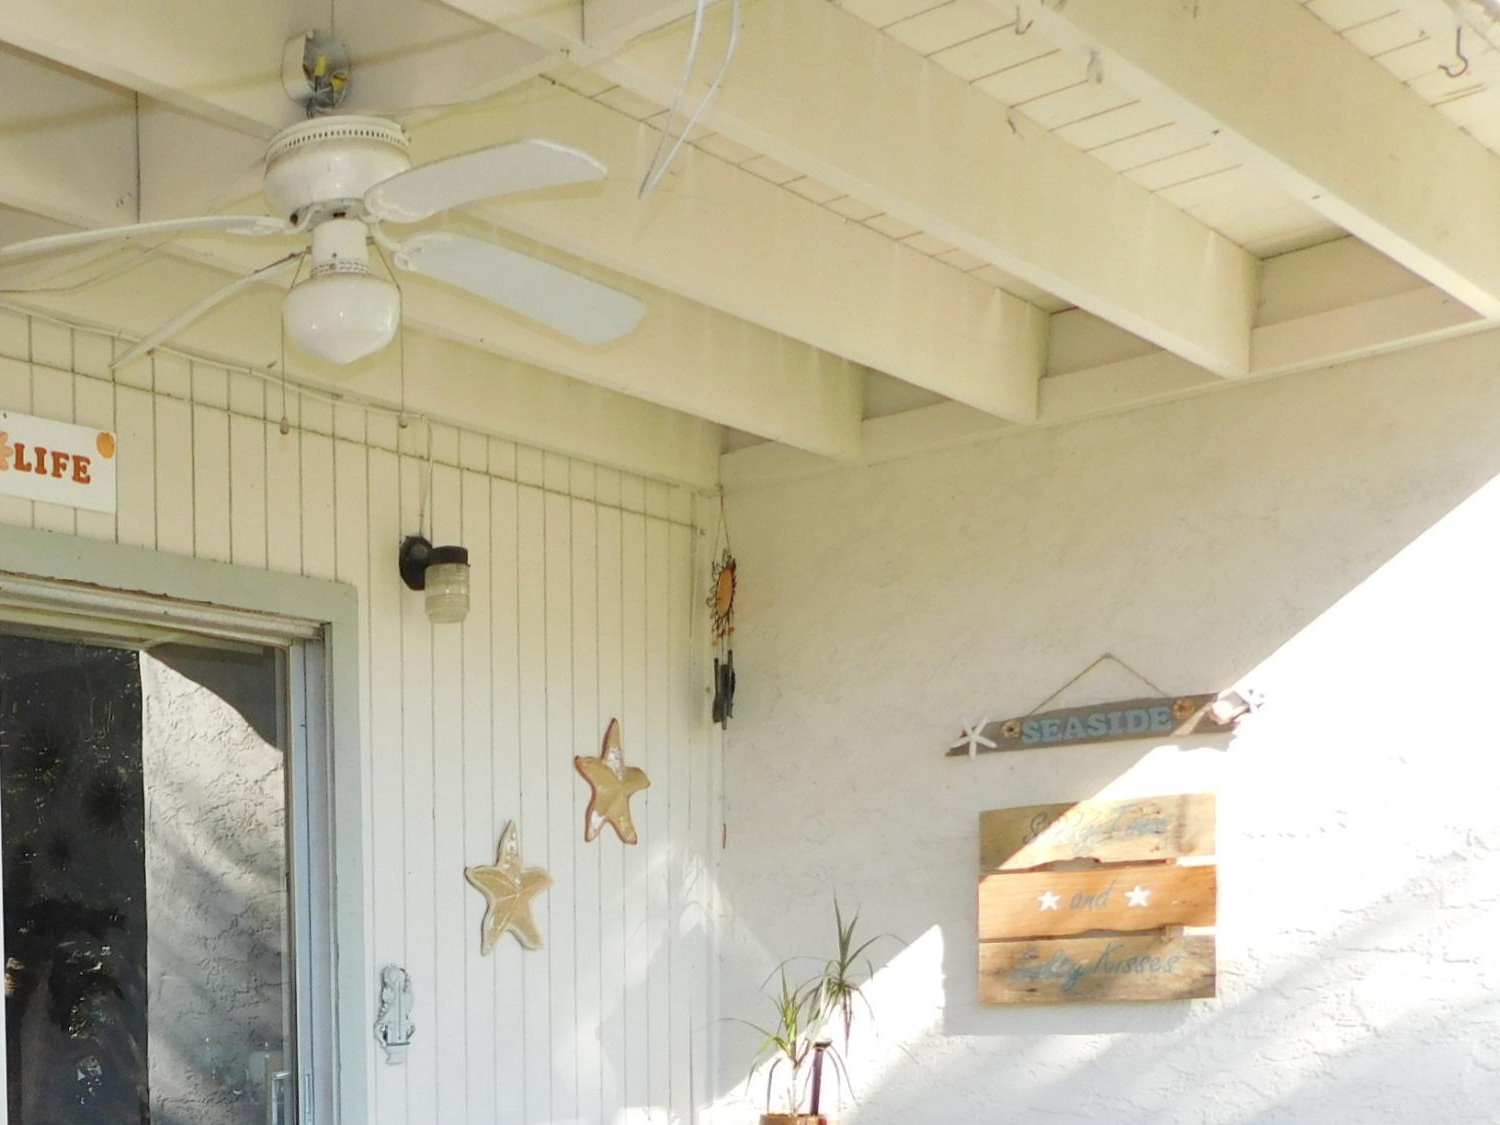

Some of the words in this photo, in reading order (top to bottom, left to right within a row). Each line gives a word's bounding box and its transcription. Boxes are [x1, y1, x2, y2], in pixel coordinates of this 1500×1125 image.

[13, 442, 92, 485] LIFE
[1021, 705, 1173, 746] SEASIDE
[1069, 879, 1118, 912] and
[1090, 941, 1183, 976] Kisses
